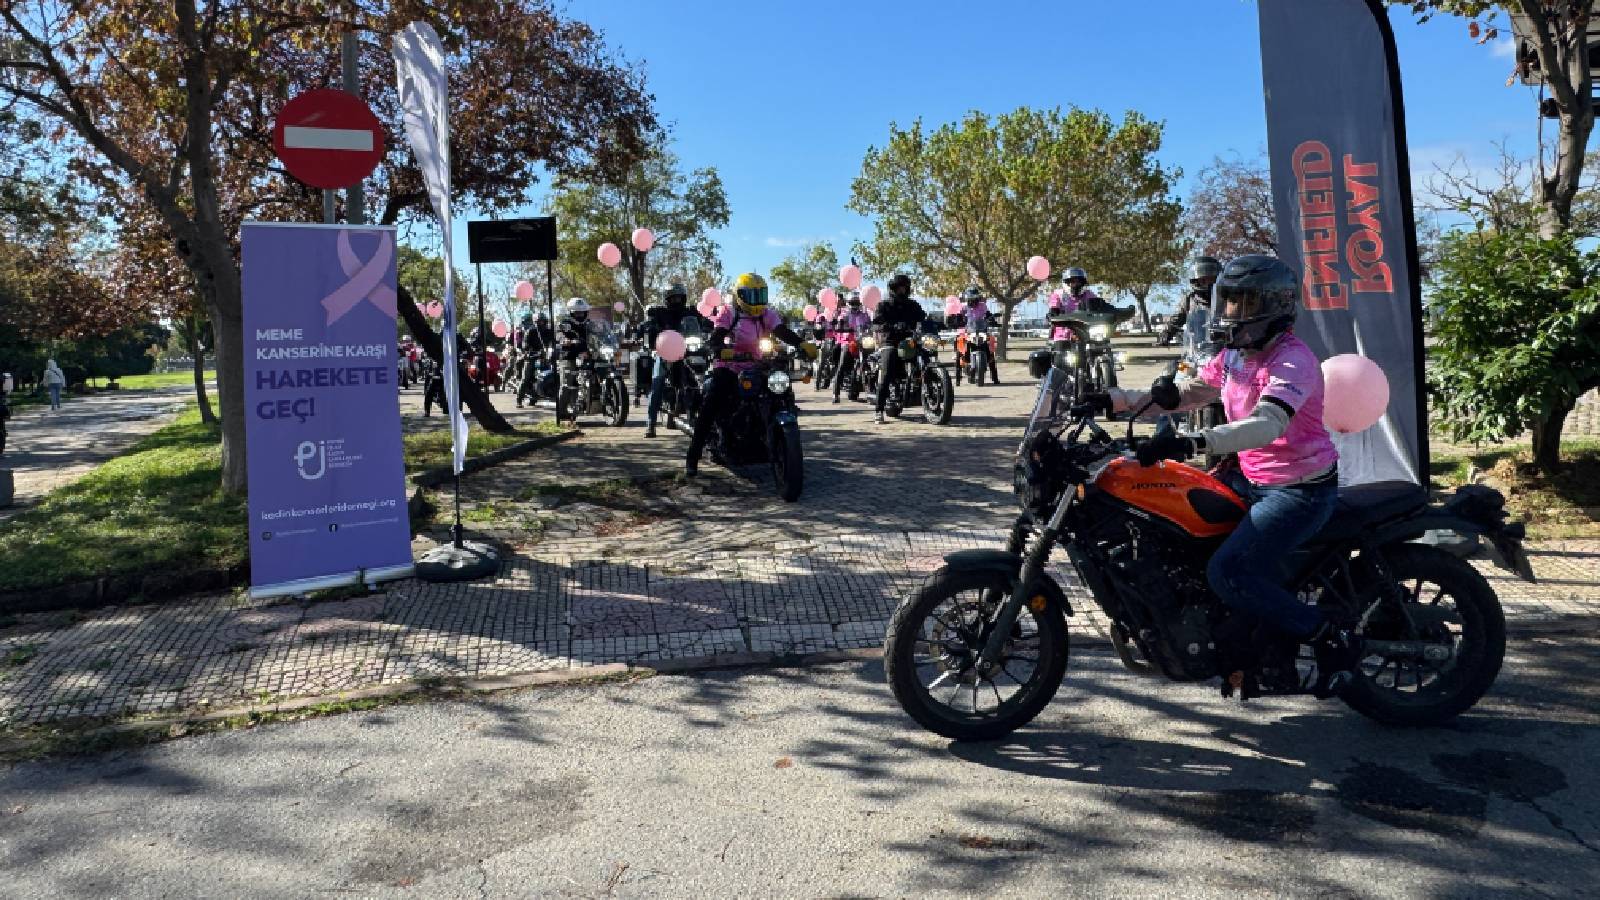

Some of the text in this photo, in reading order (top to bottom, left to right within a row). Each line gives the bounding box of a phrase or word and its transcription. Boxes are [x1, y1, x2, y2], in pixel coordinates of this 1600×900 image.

[256, 328, 303, 341] MEME
[256, 342, 386, 360] KANSERİNE KARŞI
[256, 366, 388, 390] HAREKETE
